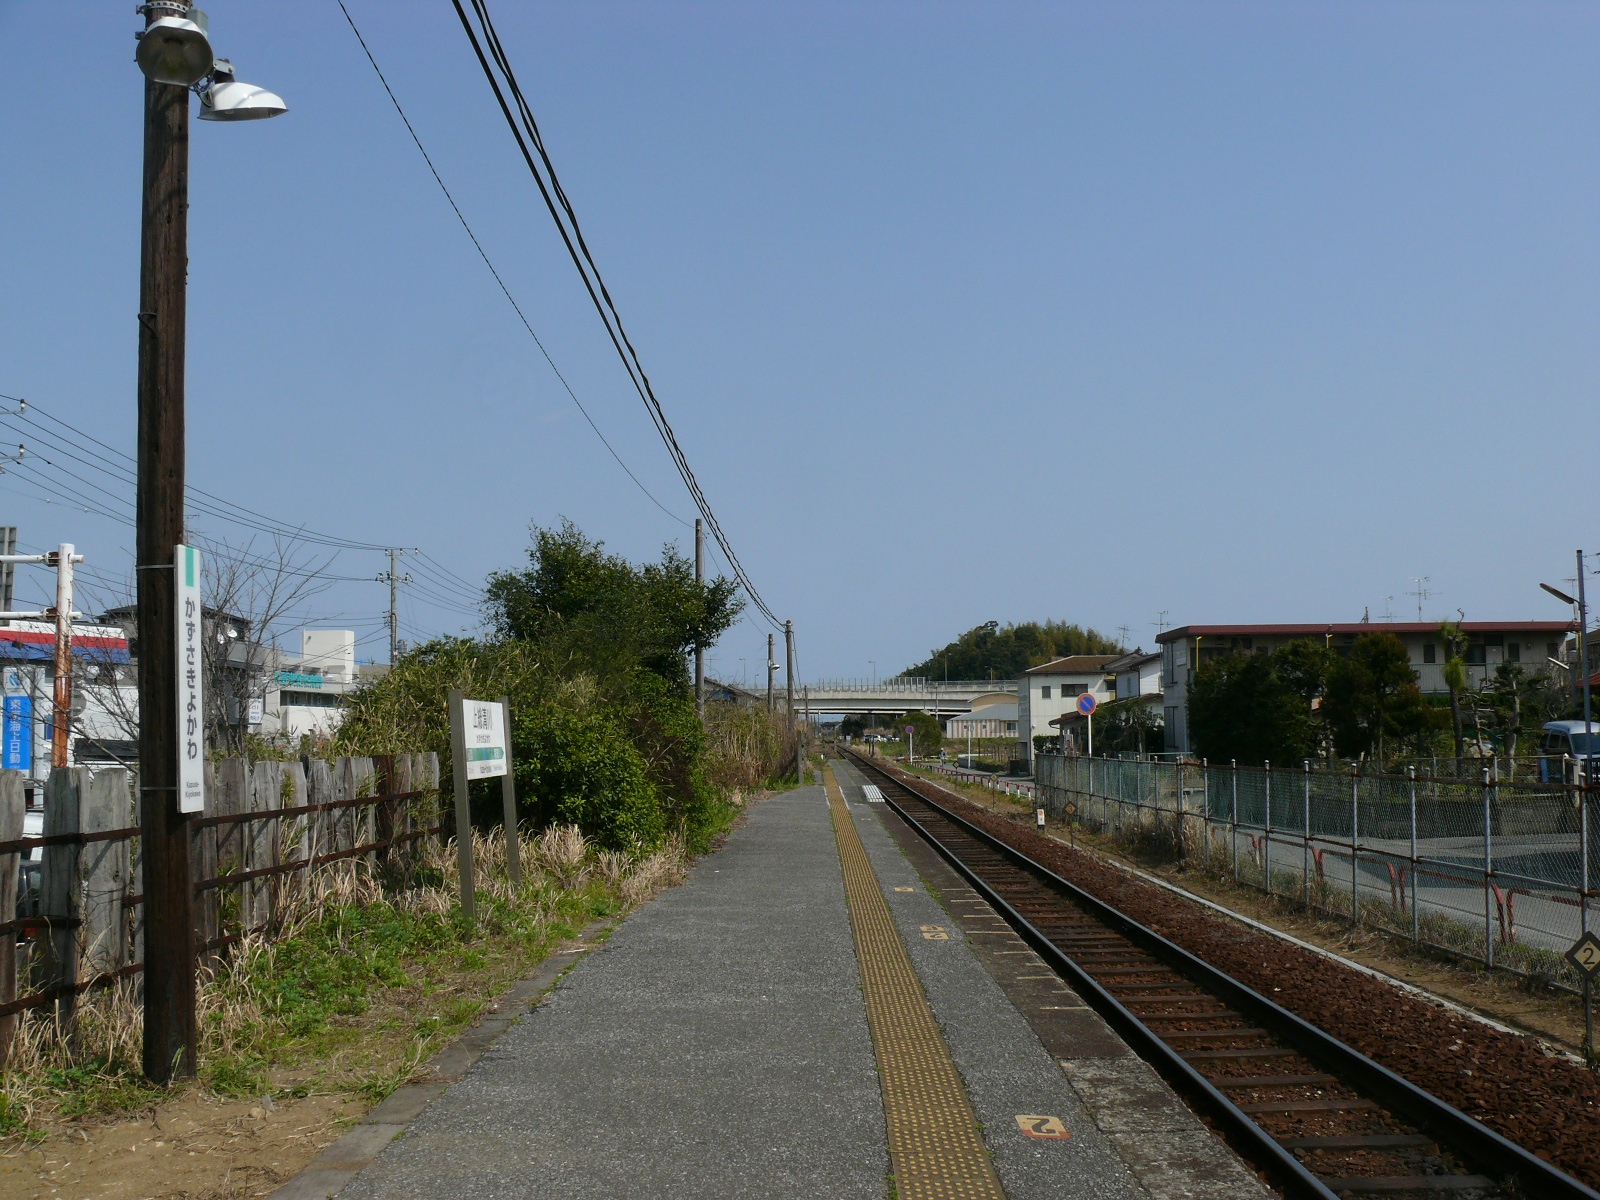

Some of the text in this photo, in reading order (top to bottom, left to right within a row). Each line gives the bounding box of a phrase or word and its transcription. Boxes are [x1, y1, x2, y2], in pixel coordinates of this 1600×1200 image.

[185, 597, 198, 760] かずさきよかわ
[9, 699, 21, 764] 東京海上日動
[1583, 948, 1595, 965] 2
[1026, 1117, 1057, 1134] 2
